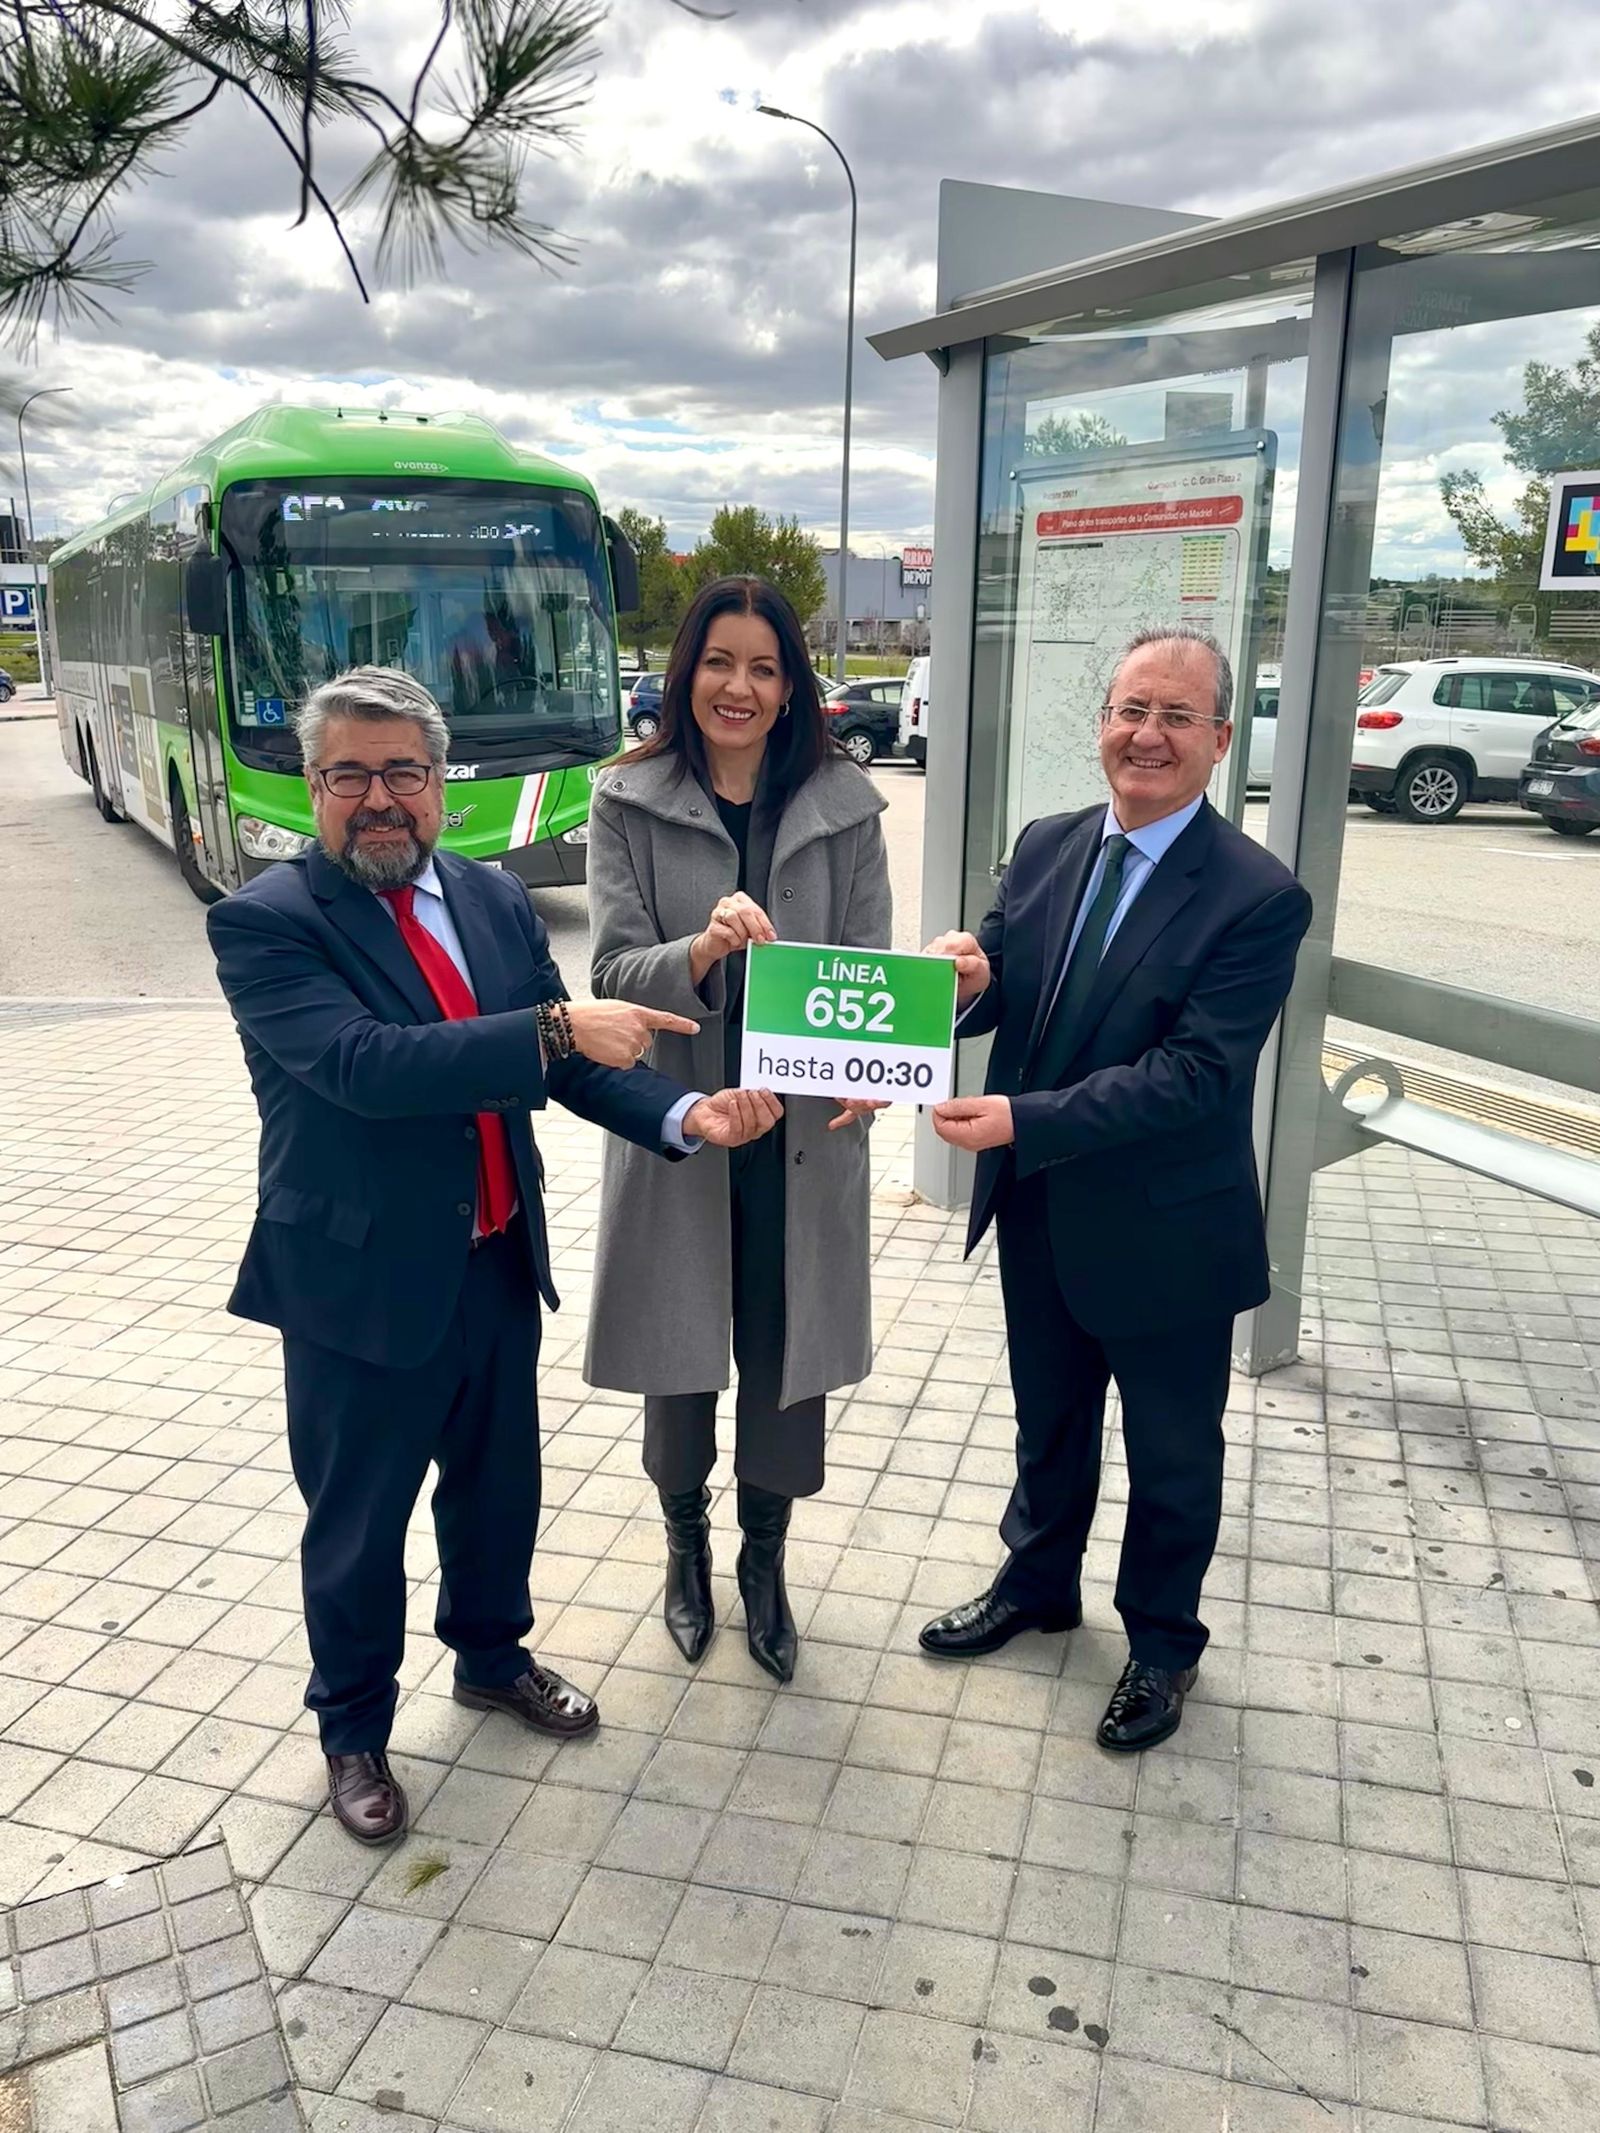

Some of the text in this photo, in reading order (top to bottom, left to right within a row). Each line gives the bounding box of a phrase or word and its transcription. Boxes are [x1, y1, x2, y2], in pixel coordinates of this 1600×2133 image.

[393, 461, 438, 470] avanza
[1200, 475, 1216, 485] Gran
[1128, 514, 1136, 523] de
[1143, 511, 1179, 523] Comunidad
[1180, 509, 1188, 519] de
[1189, 508, 1213, 518] Madrid
[903, 550, 932, 565] BRICO
[4, 590, 25, 615] P
[445, 764, 480, 779] zar
[818, 957, 887, 985] LÍNEA
[805, 986, 896, 1033] 652
[758, 1048, 933, 1088] hasta 00:30
